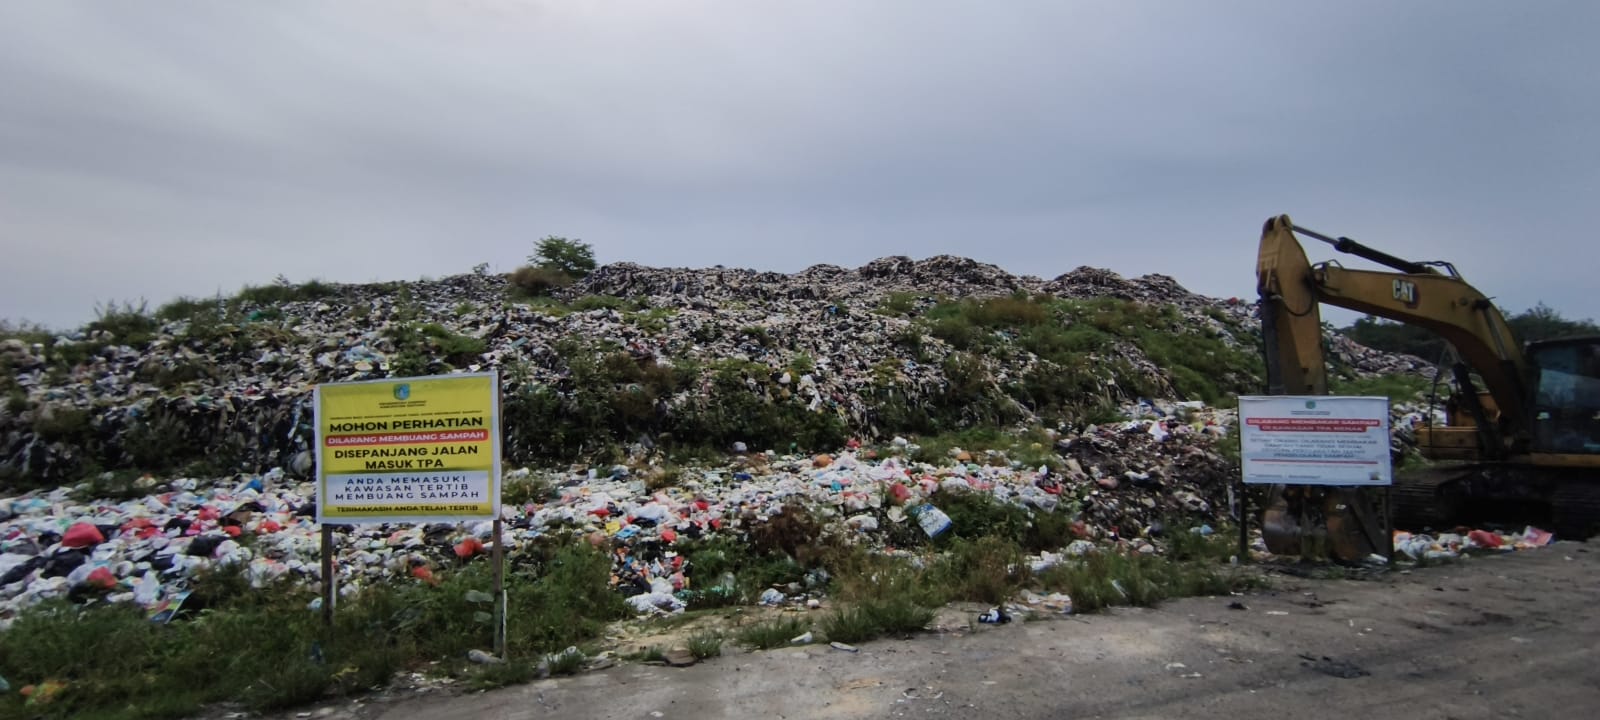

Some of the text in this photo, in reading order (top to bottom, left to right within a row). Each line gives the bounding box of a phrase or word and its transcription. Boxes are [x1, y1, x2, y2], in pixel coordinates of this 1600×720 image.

[1392, 278, 1415, 303] CAT
[330, 417, 483, 432] MOHON PERHATIAN
[328, 431, 484, 444] DILARANG MEMBUANG SAMPAH
[335, 445, 478, 459] DISEPANJANG JALAN
[365, 458, 444, 470] MASUK TPA
[346, 475, 466, 485] ANDA MEMASUKI
[344, 483, 469, 492] KAWASAN TERTIB
[335, 491, 479, 500] MEMBUANG SAMPAH
